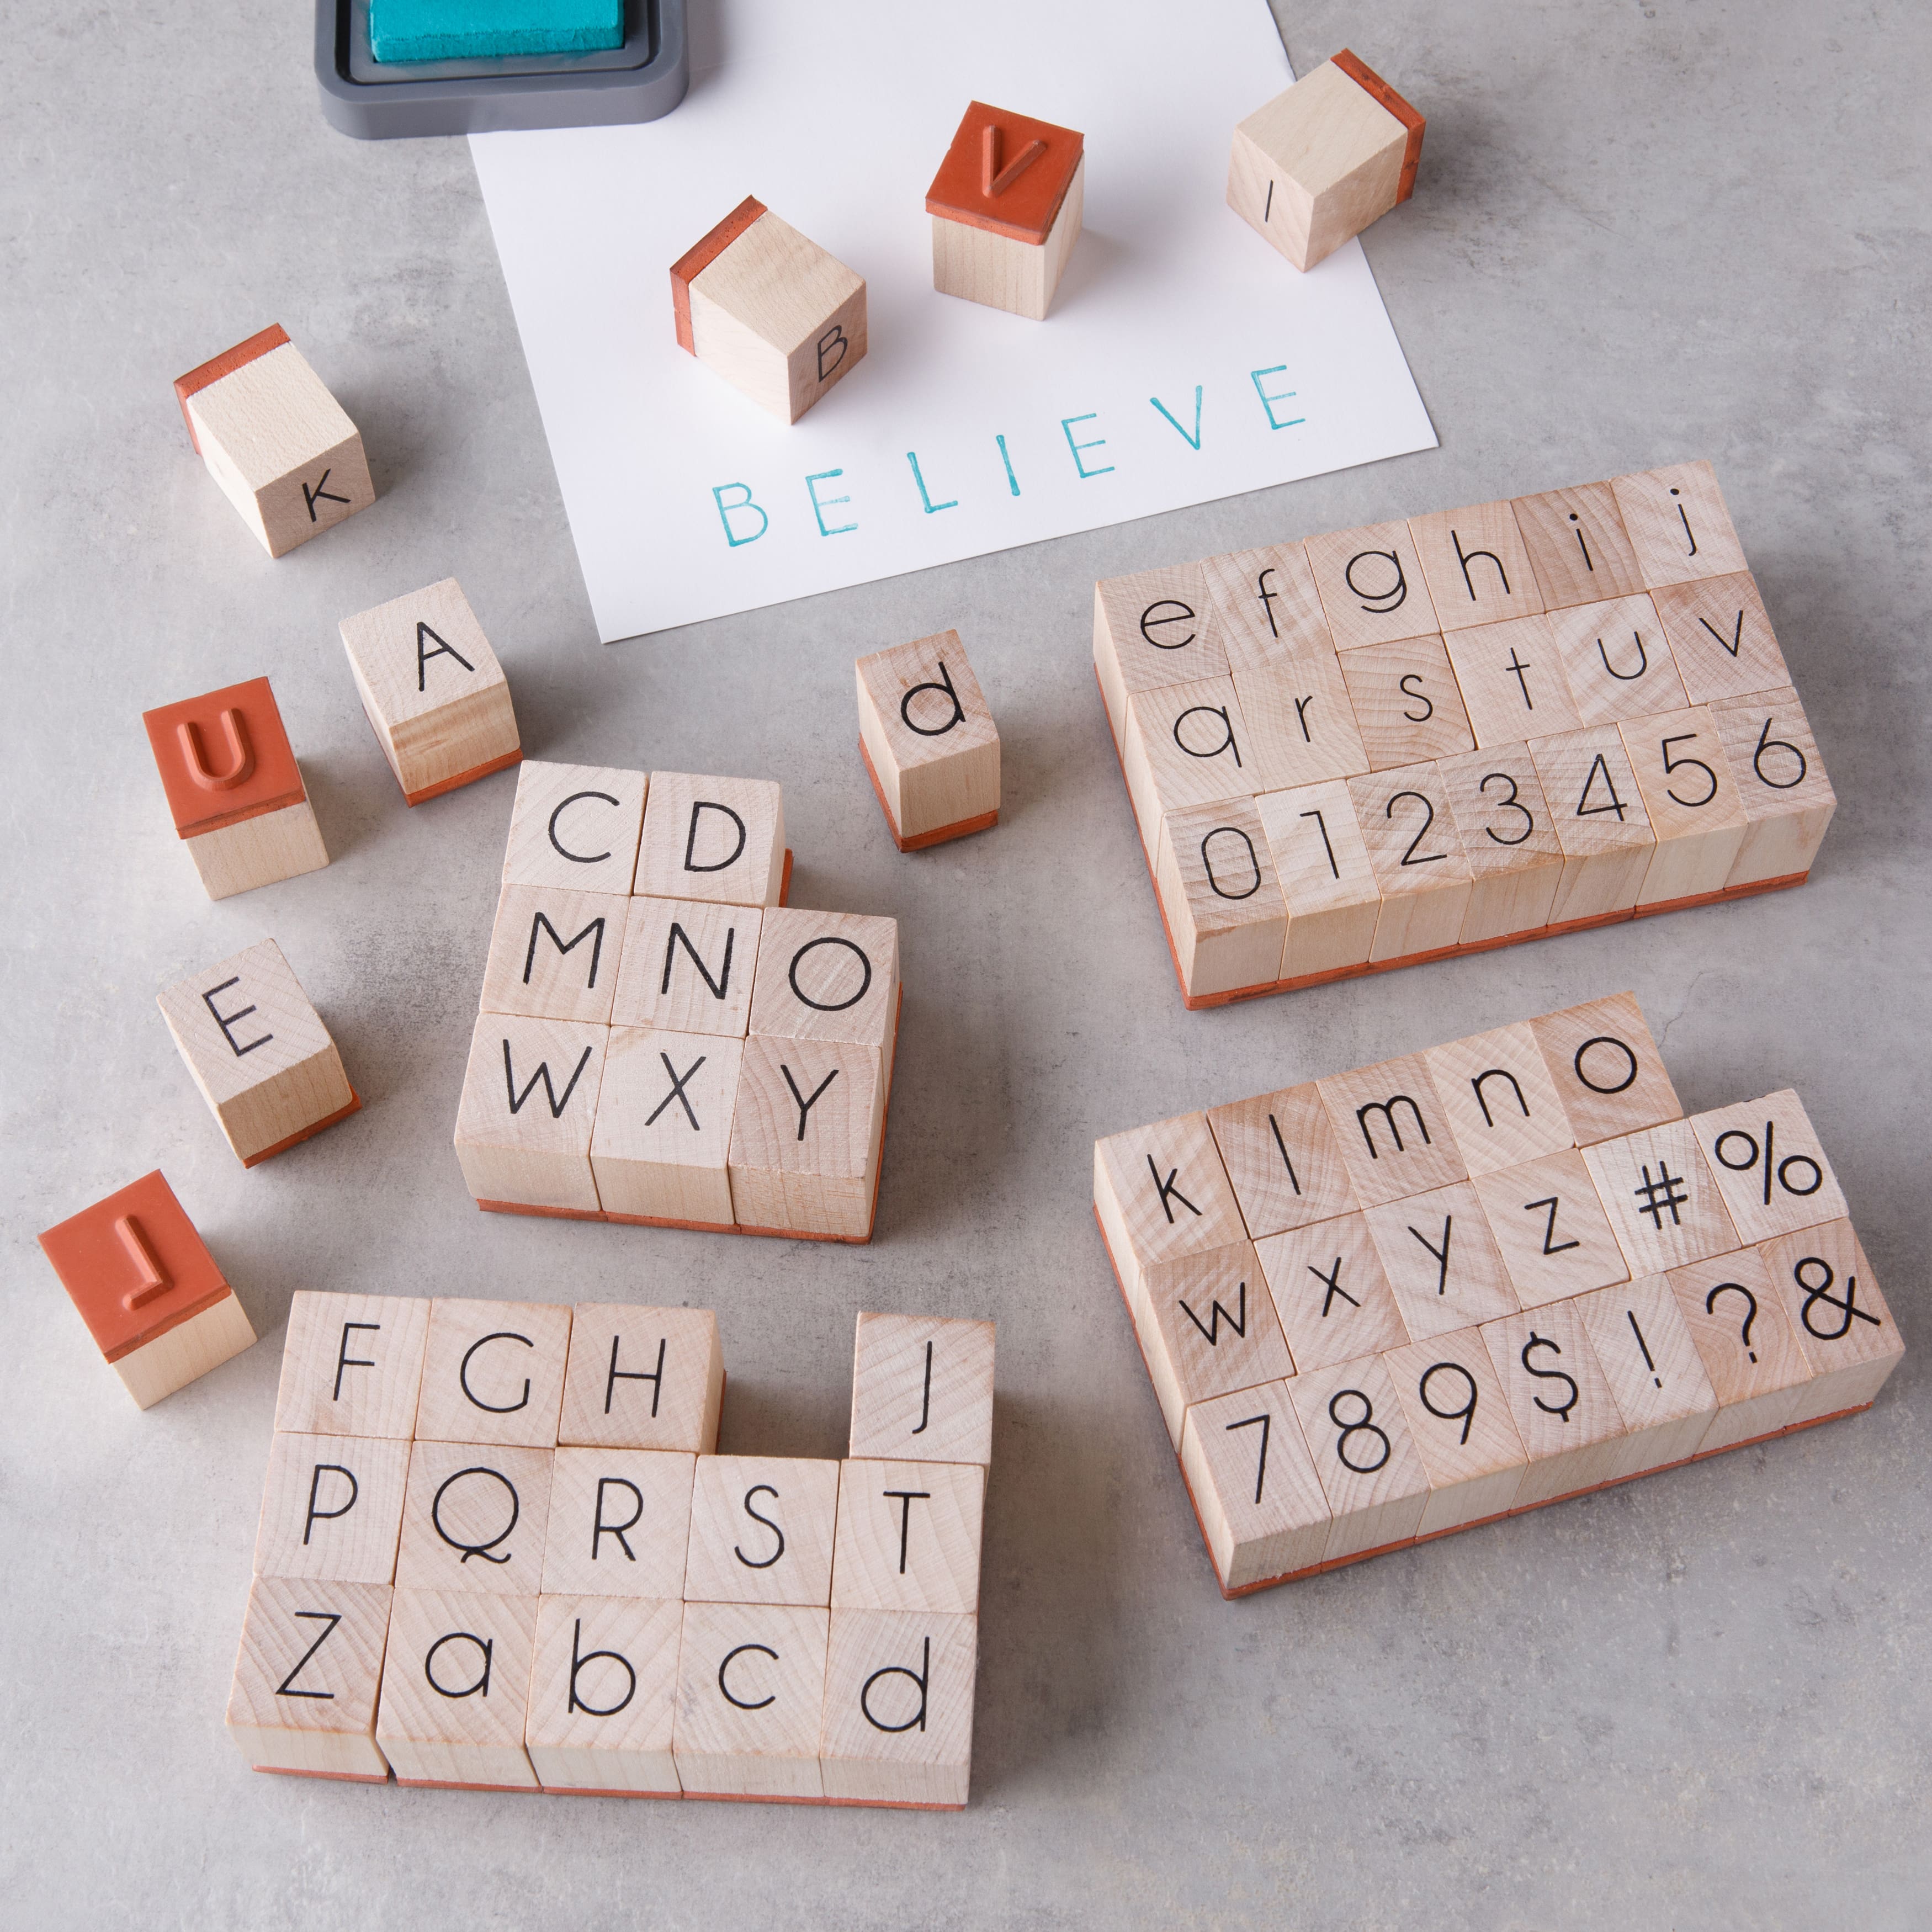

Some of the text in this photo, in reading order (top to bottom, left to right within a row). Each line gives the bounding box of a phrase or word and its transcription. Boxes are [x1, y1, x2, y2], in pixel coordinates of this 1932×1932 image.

[981, 123, 1047, 199] V
[818, 325, 848, 383] B
[302, 469, 351, 522] K
[712, 365, 1305, 547] BELIEVE
[1140, 489, 1697, 649] e f g h i j
[417, 622, 475, 692] A
[1174, 610, 1743, 767] q r s t u v
[176, 705, 257, 793] U
[1300, 810, 1339, 879] 1
[1387, 792, 1447, 866] 2
[1480, 773, 1533, 845] 3
[1577, 754, 1627, 821] 4
[1662, 734, 1717, 806] 5
[1754, 718, 1806, 789] 6
[548, 792, 746, 872] C D
[202, 976, 273, 1057] E
[523, 912, 871, 1011] M N O
[503, 1039, 839, 1141] W X Y
[1147, 1154, 1202, 1224] k
[1356, 1095, 1431, 1159] m
[1471, 1069, 1530, 1127] n
[1179, 1121, 1822, 1346] w x y z # %
[333, 1323, 932, 1434] F G H J
[1226, 1257, 1881, 1504] 7 8 9 $ ! ? &
[304, 1464, 930, 1574] P Q R S T
[275, 1612, 930, 1733] Z a b c d
